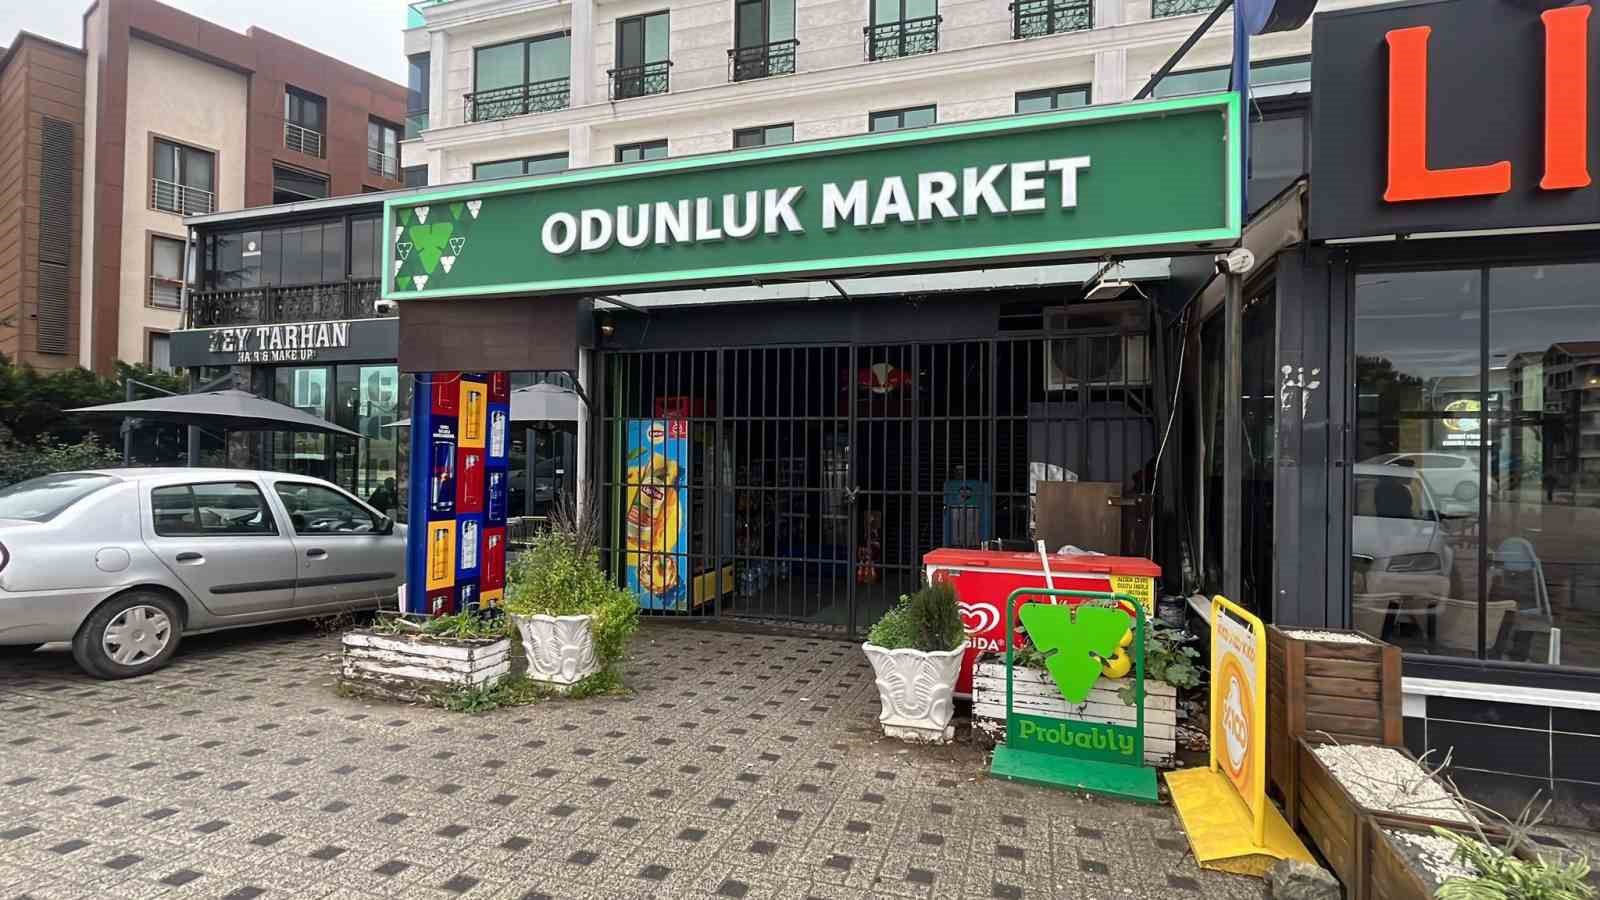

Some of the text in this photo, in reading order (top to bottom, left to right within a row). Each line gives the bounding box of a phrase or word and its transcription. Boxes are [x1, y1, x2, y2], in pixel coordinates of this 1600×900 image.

[541, 155, 1091, 255] ODUNLUK MARKET
[256, 322, 349, 350] TARHAN
[262, 350, 269, 361] &
[271, 350, 297, 361] MAKE
[300, 349, 313, 360] UP
[1018, 719, 1135, 756] Probably
